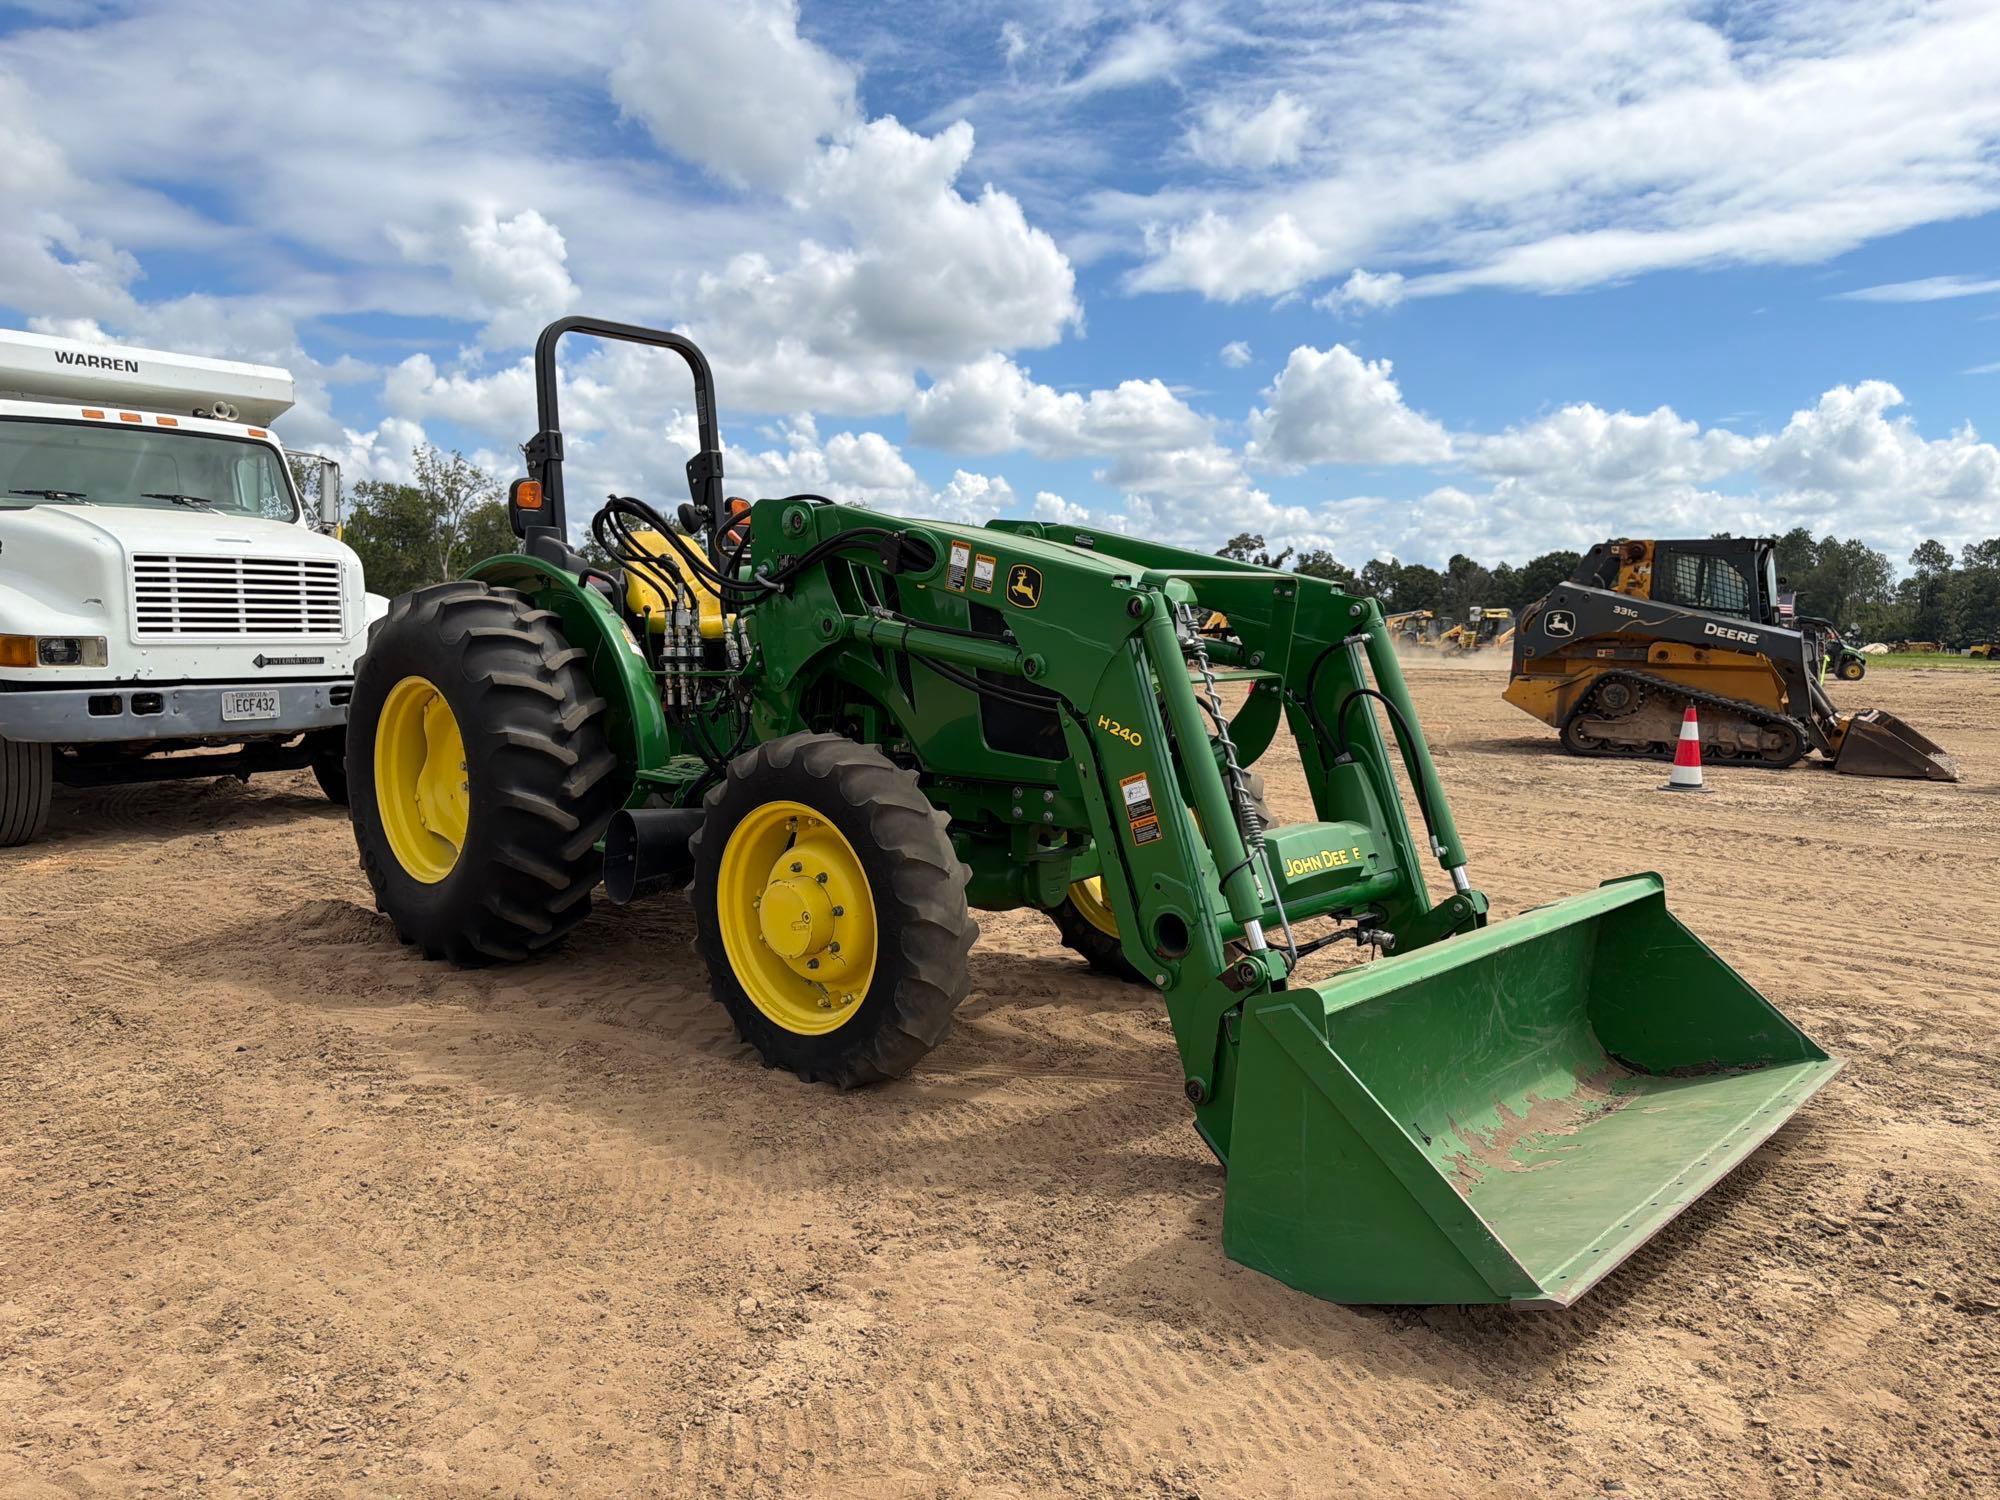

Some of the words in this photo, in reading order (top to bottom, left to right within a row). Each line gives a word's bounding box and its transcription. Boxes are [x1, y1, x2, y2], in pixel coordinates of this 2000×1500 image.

[55, 351, 138, 373] WARREN
[1613, 605, 1639, 618] 331G
[1704, 622, 1760, 645] DEERE
[236, 698, 275, 713] ECF432
[1097, 714, 1142, 747] H240
[1286, 855, 1322, 877] JOHN
[1320, 847, 1361, 868] DEEE
